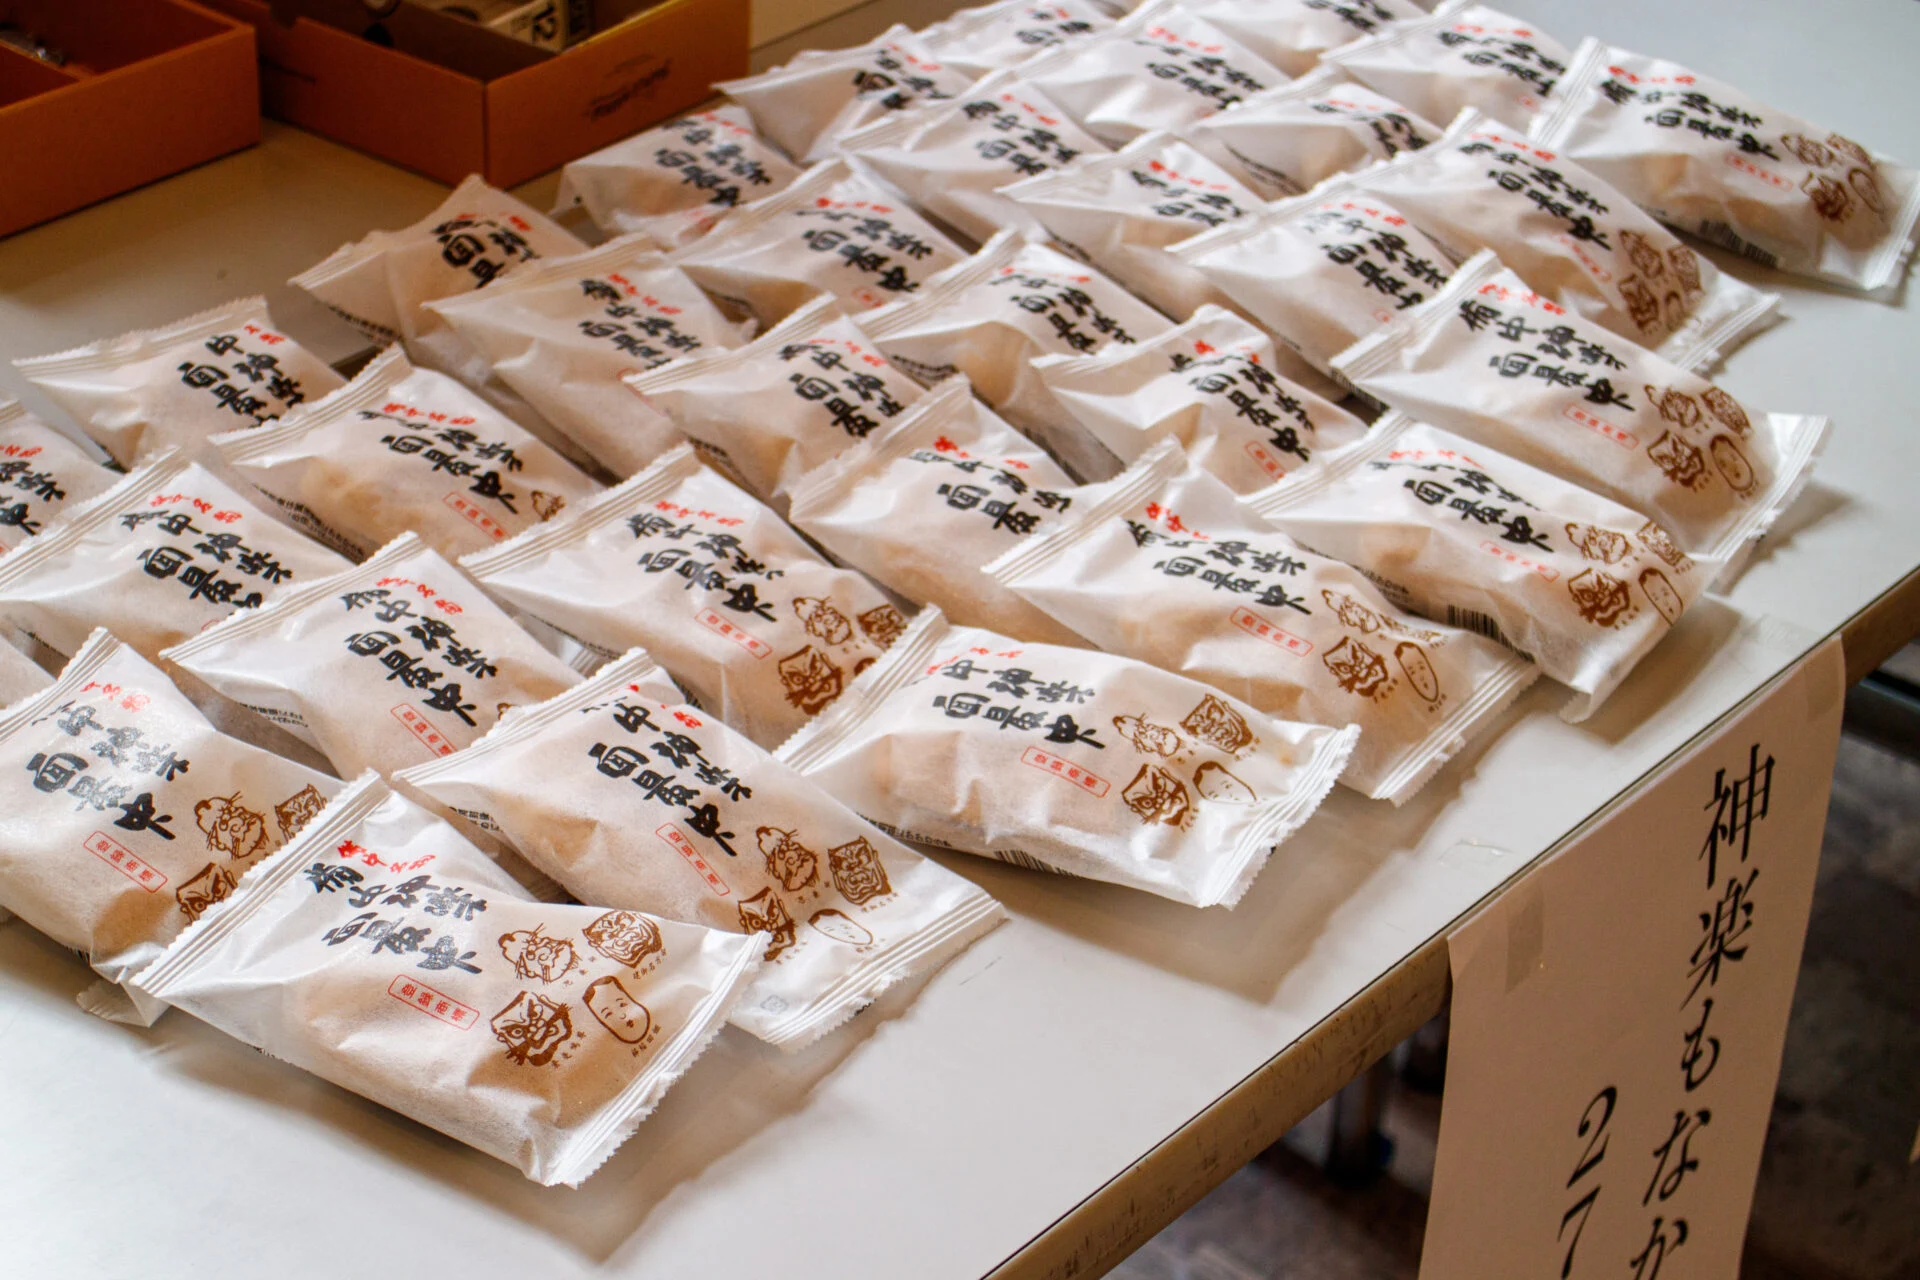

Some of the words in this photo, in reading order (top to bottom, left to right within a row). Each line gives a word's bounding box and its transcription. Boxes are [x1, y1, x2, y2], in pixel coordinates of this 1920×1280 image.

[1630, 742, 1777, 1280] 神楽もなか
